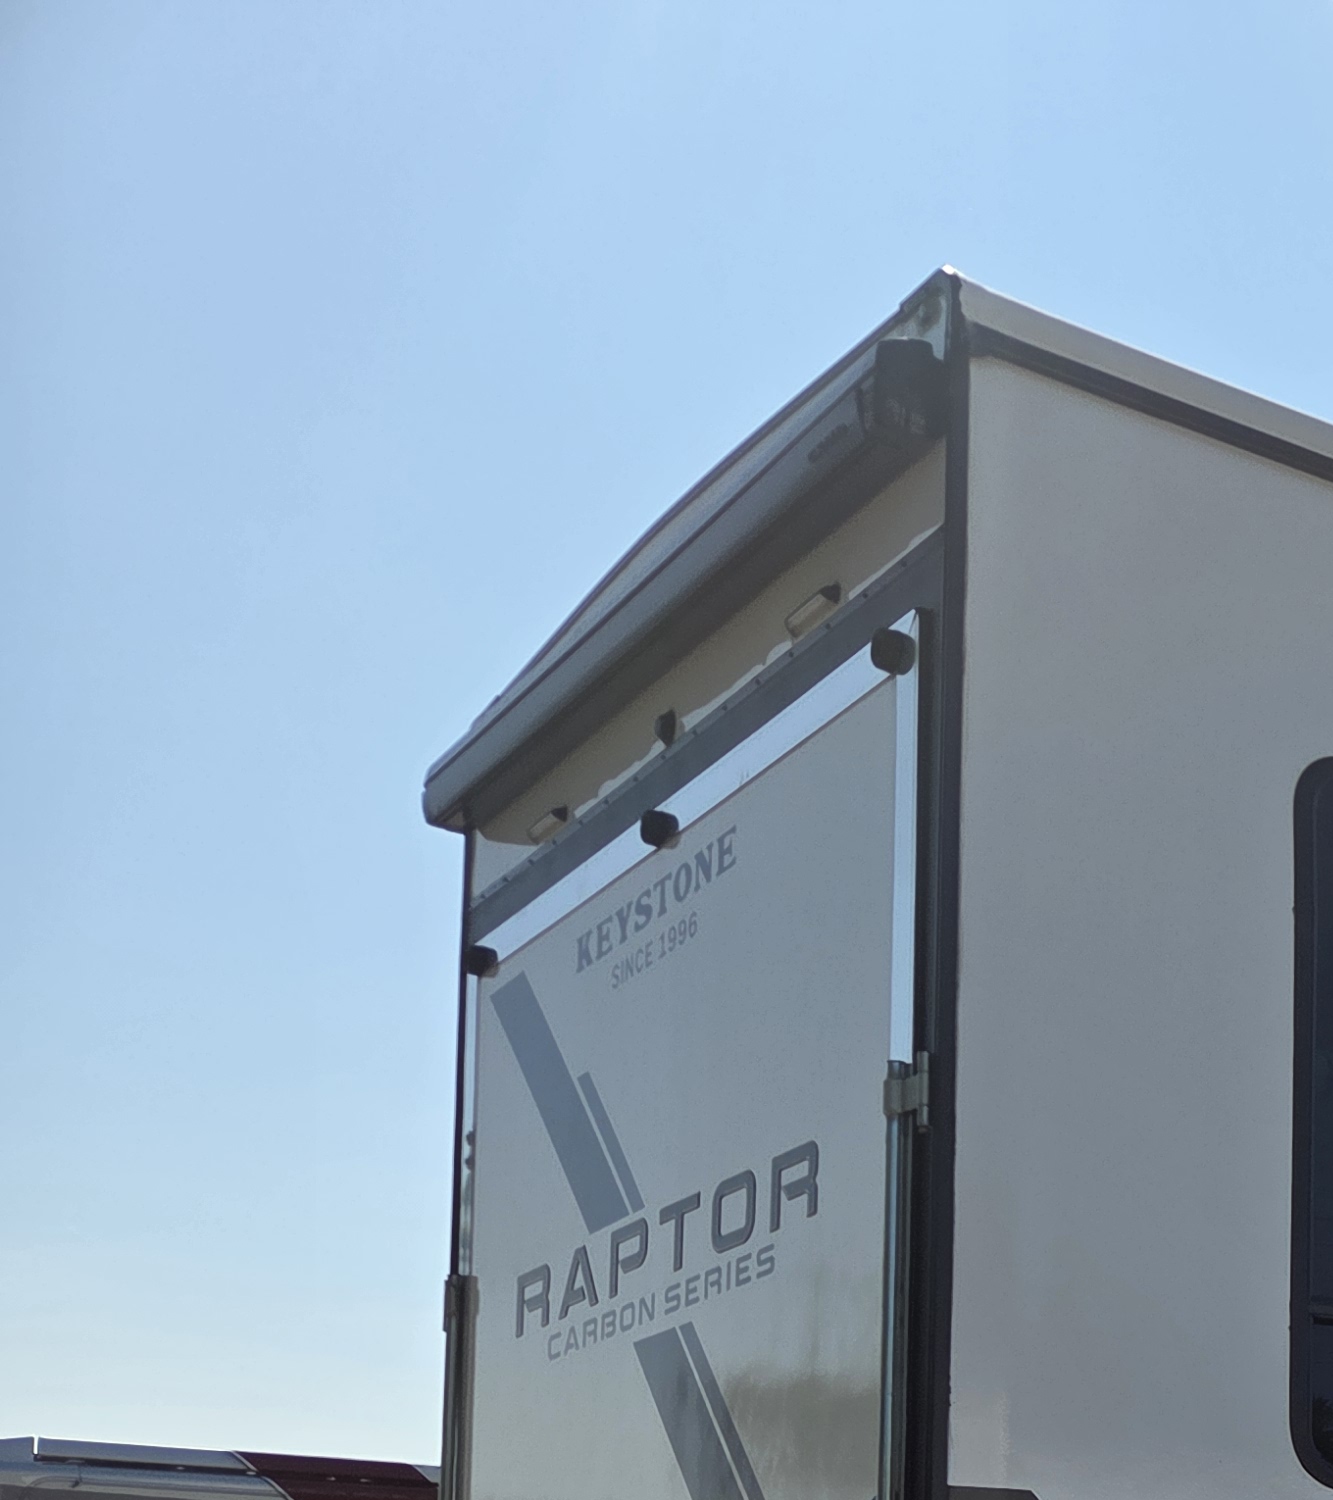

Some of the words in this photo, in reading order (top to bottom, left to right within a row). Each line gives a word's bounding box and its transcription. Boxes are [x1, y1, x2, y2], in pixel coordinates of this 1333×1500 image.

[576, 824, 738, 974] KEYSTONE
[611, 940, 653, 989] SINCE
[658, 911, 698, 960] 1996
[515, 1139, 819, 1339] RAPTOR
[547, 1292, 656, 1362] CARBON
[664, 1243, 775, 1316] SERIES
